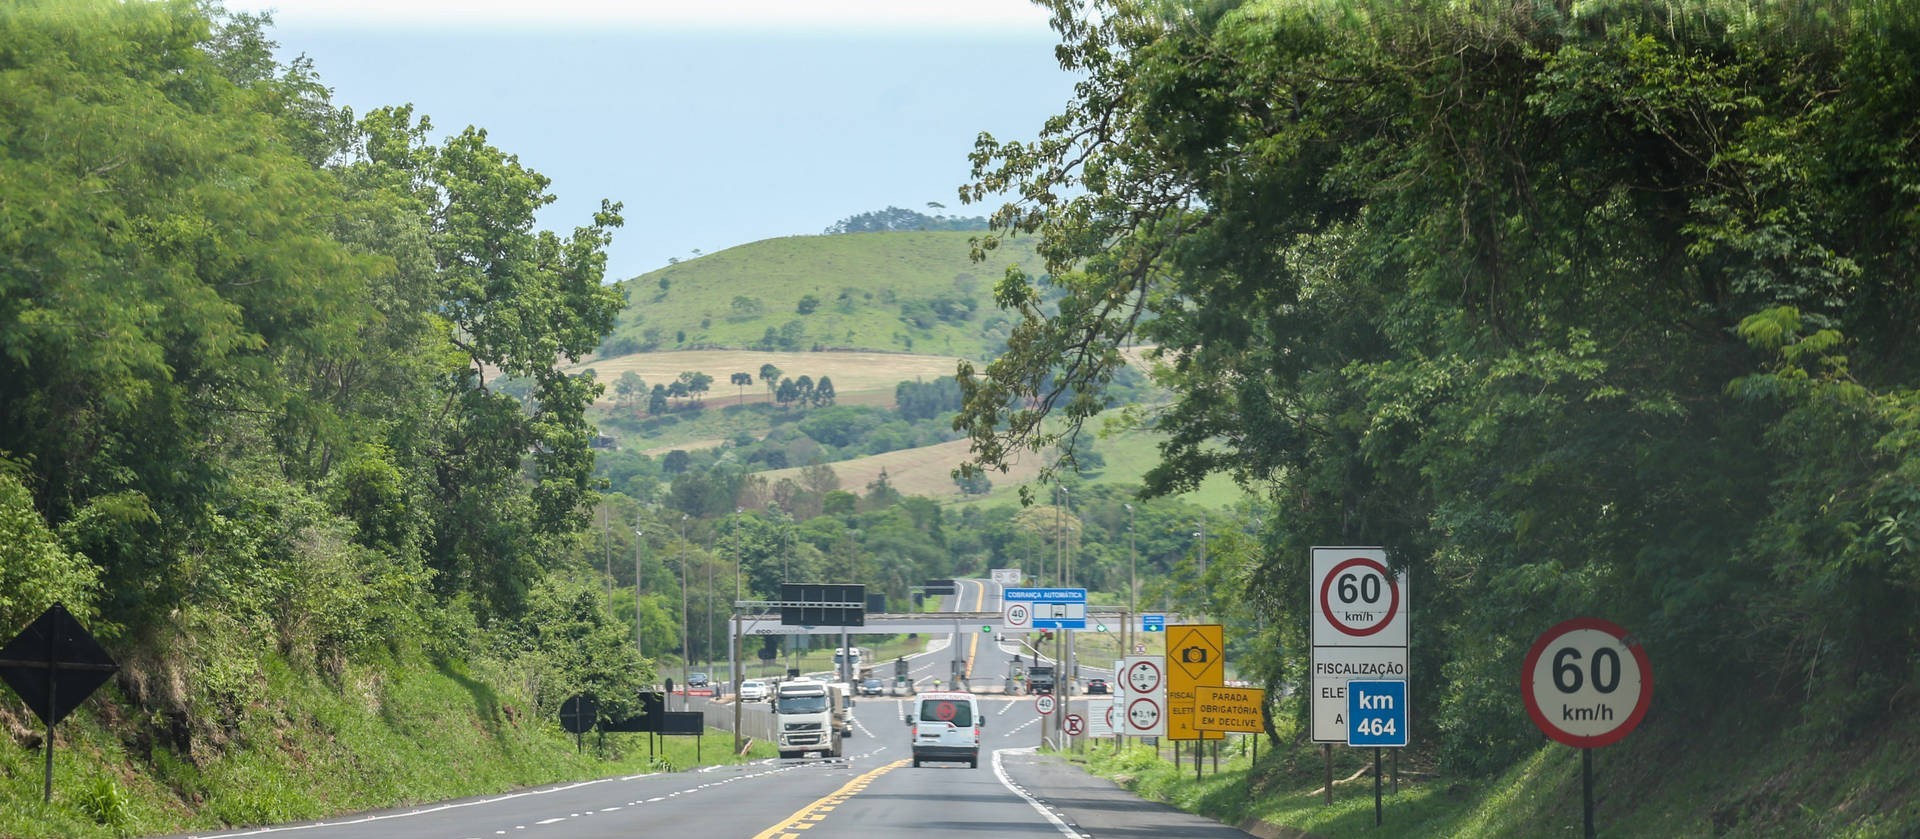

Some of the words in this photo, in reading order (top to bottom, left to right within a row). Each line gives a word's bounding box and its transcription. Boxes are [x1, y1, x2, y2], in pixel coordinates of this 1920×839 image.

[1337, 573, 1381, 604] 60
[1012, 610, 1024, 618] 40
[1345, 611, 1374, 622] km/h
[1316, 662, 1404, 678] FISCALIZAÇÃO
[1552, 646, 1621, 694] 60
[1212, 693, 1248, 702] PARADA
[1322, 687, 1347, 699] ELE
[1039, 699, 1051, 707] 40
[1359, 691, 1394, 710] km
[1200, 704, 1258, 715] OBRIGATÓRIA
[1562, 703, 1613, 721] km/h
[1202, 716, 1215, 725] EM
[1219, 719, 1256, 727] DECLIVE
[1335, 713, 1344, 725] A
[1357, 717, 1396, 736] 464
